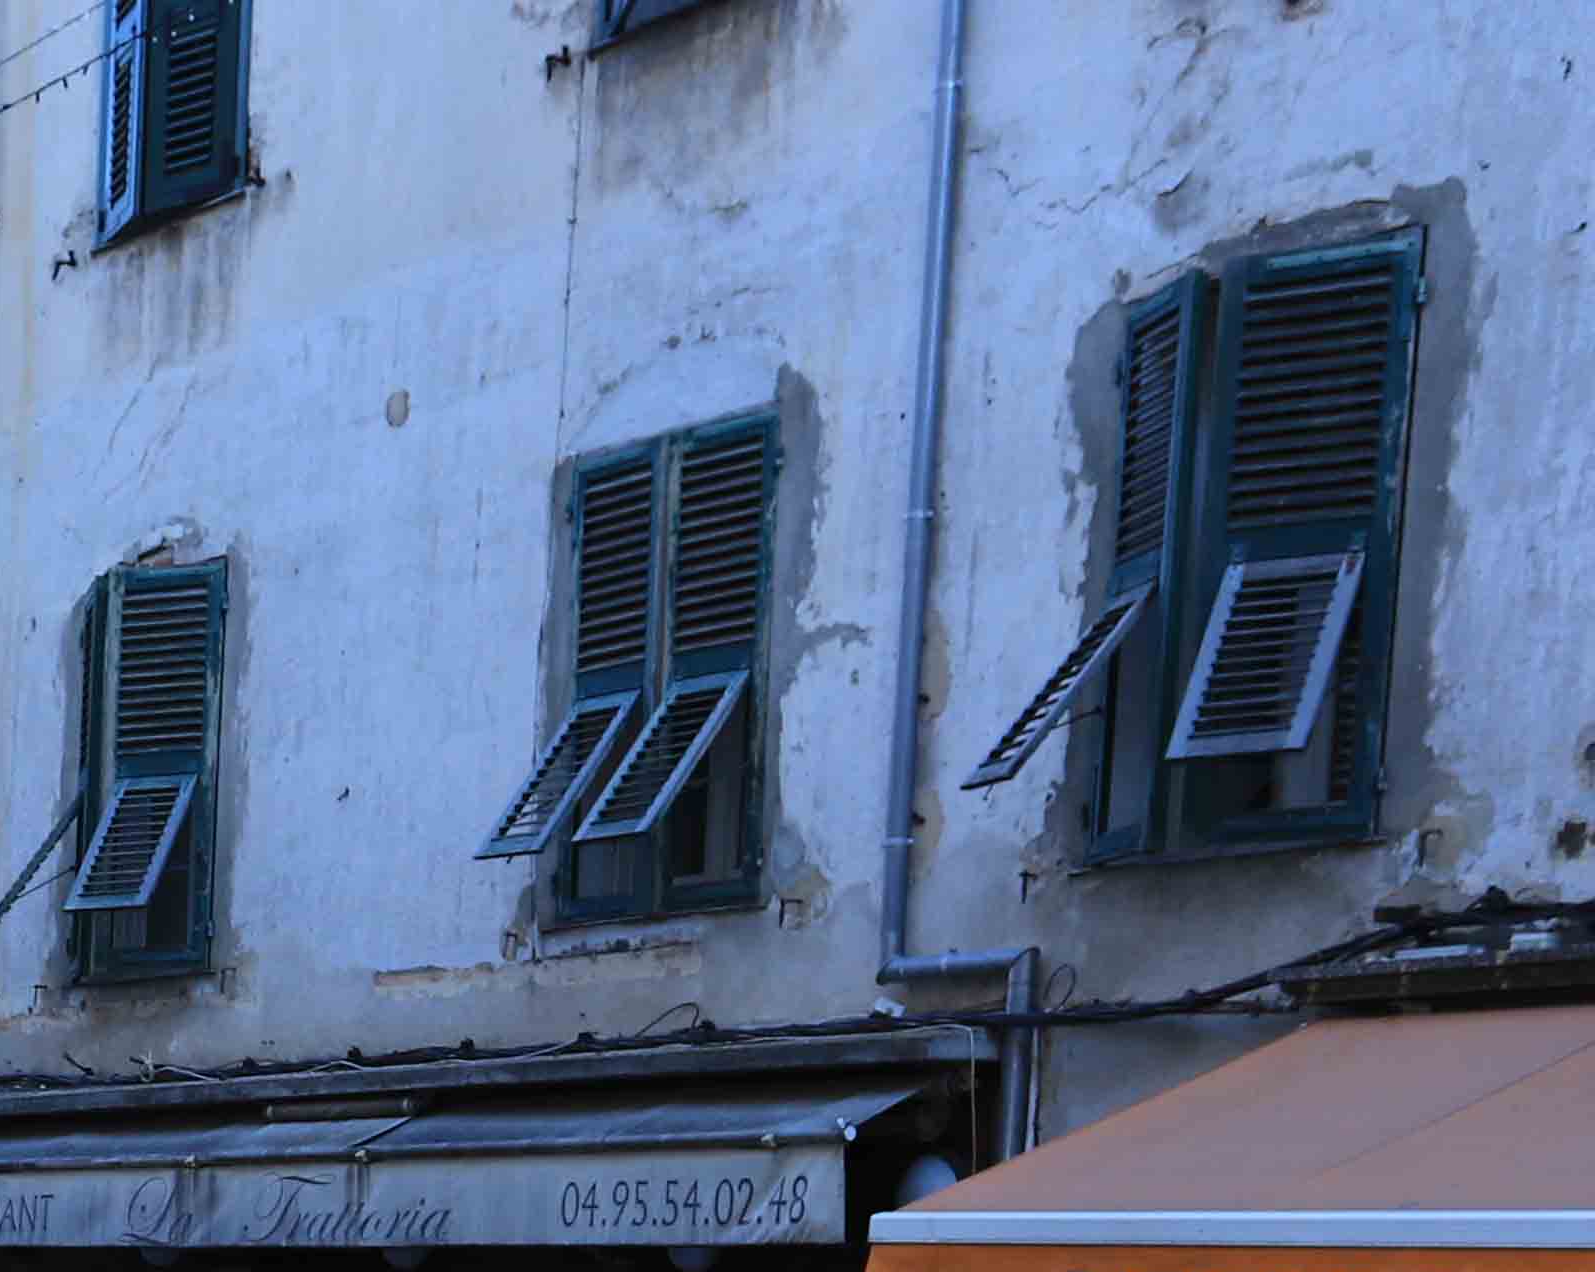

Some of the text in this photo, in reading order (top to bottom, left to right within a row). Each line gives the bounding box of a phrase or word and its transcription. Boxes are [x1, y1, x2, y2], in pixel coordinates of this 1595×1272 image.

[121, 1176, 197, 1247] La
[242, 1173, 454, 1243] Trattoria
[561, 1175, 810, 1229] 04.95.54.02.48
